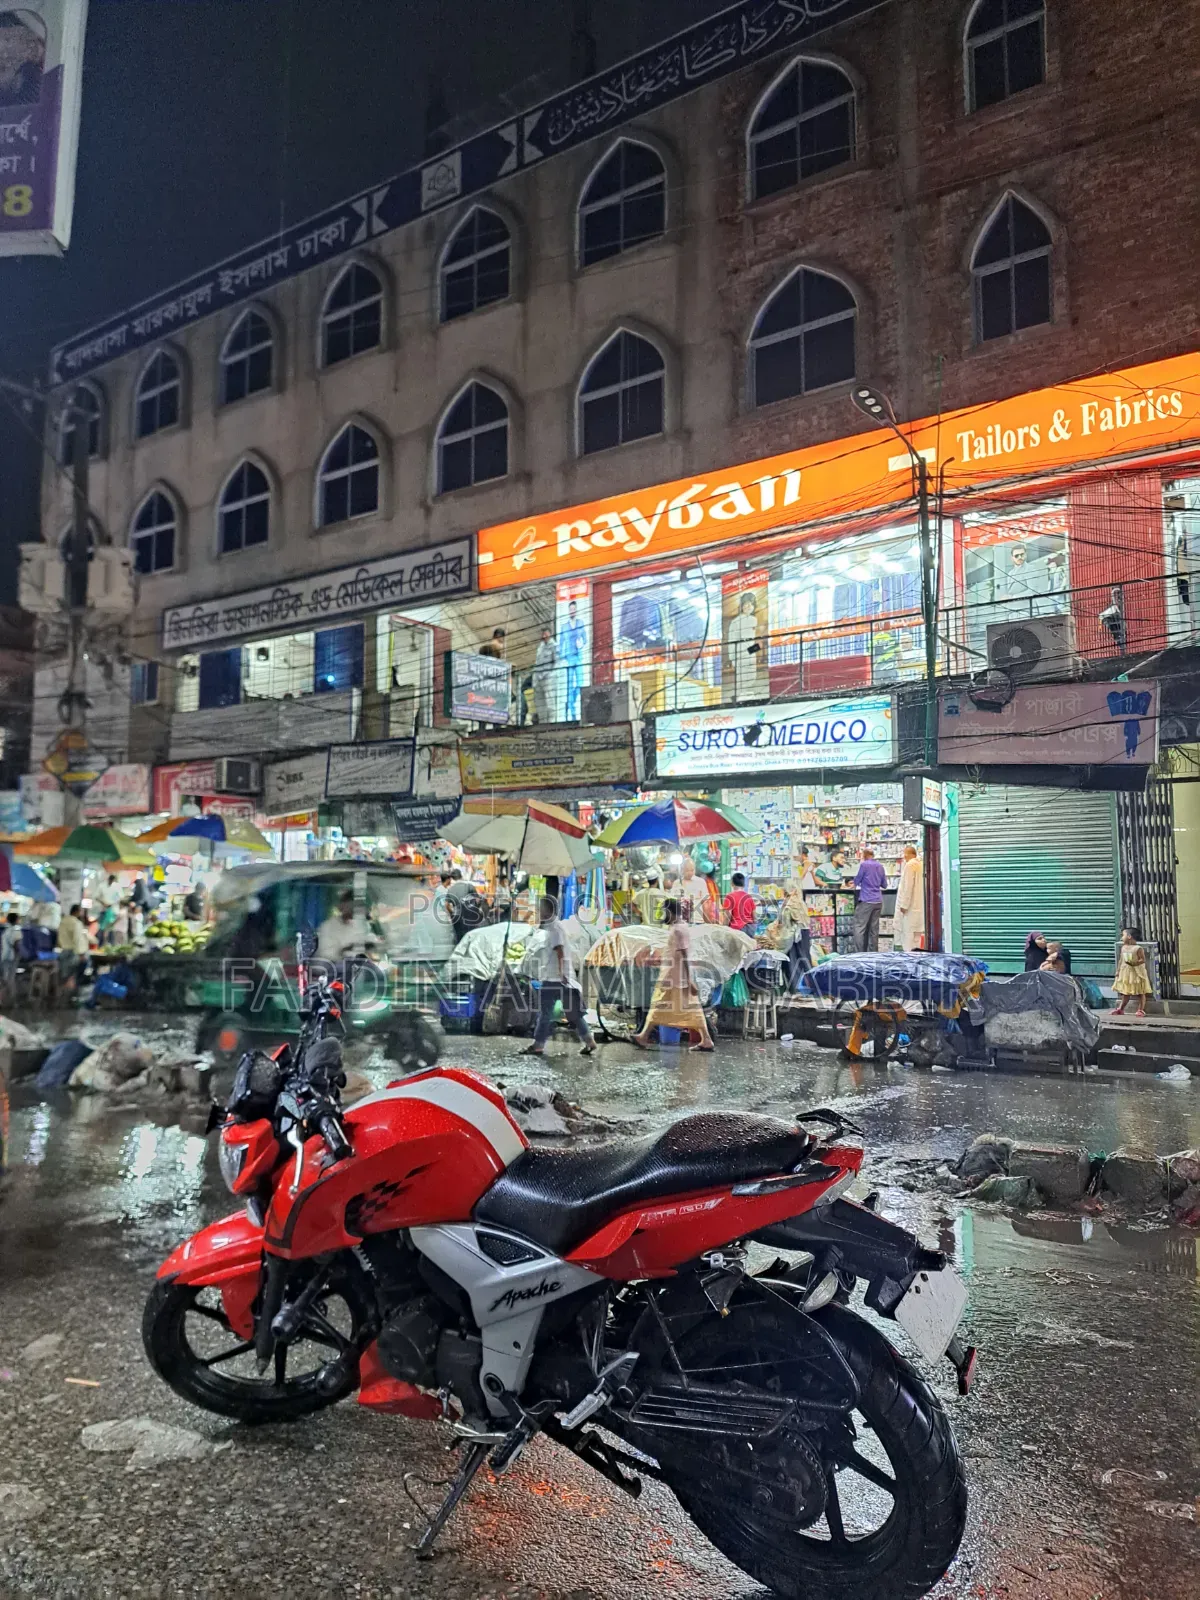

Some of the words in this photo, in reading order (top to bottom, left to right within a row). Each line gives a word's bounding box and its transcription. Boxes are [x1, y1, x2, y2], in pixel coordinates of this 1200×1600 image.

[217, 245, 292, 295] ইসলাম
[296, 216, 349, 258] ঢাকা
[956, 423, 1041, 462] Tailors
[1048, 409, 1072, 443] &
[1080, 389, 1183, 437] Fabrics
[770, 719, 867, 746] MEDICO
[488, 1278, 564, 1313] Apache
